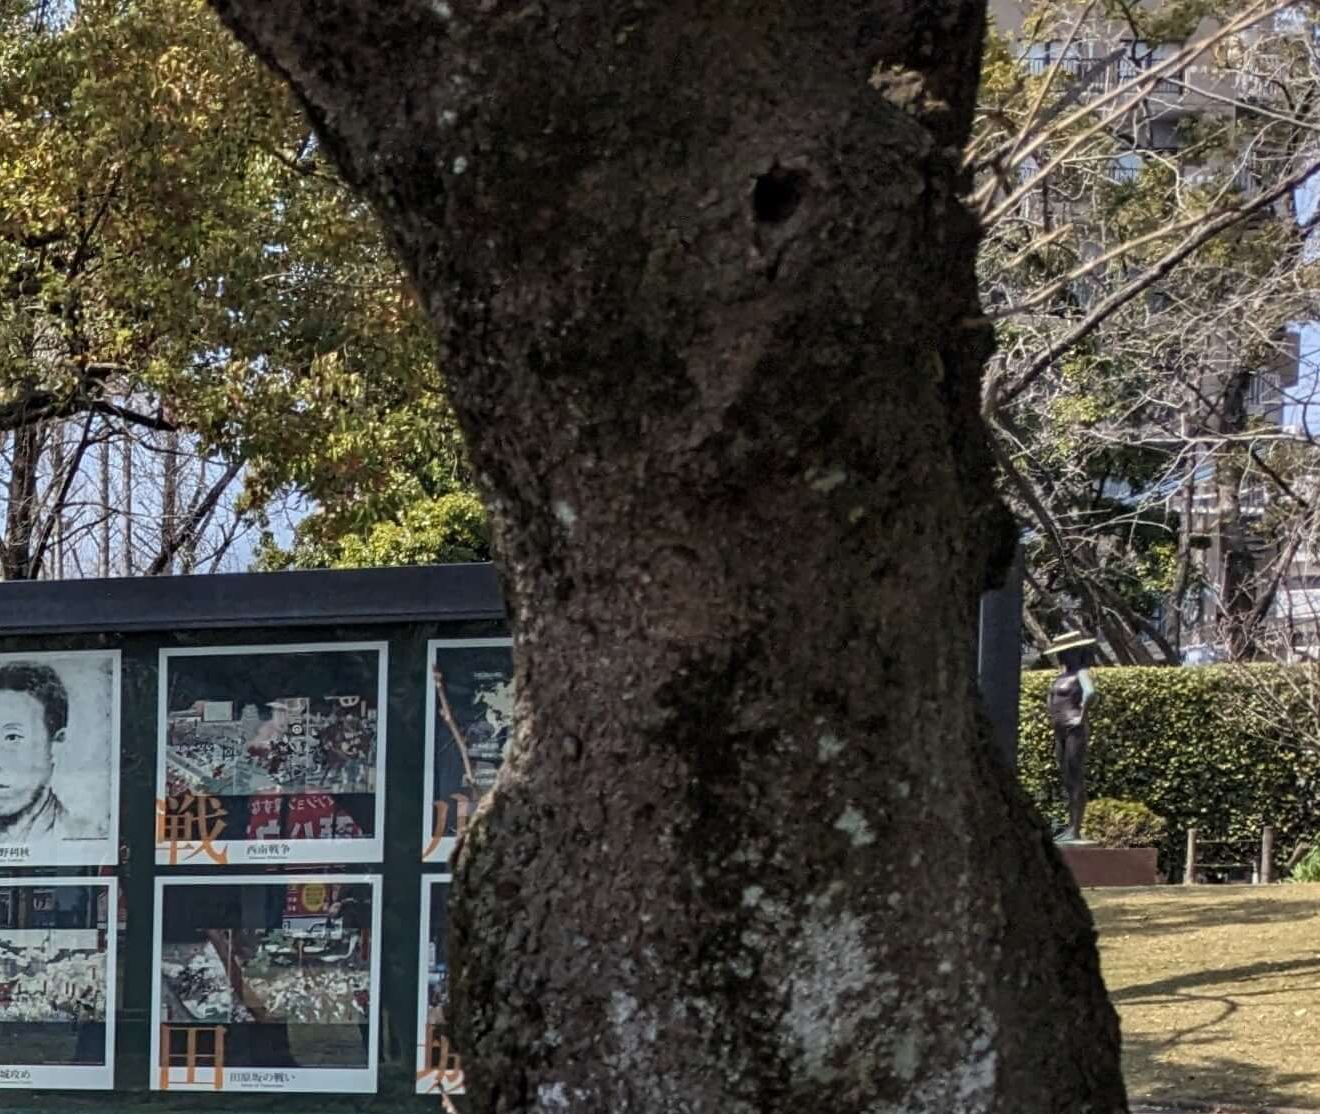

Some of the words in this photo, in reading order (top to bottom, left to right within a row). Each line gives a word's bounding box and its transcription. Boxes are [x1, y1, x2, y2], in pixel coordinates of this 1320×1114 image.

[157, 795, 228, 865] 戦
[246, 844, 291, 856] 西南戦争
[159, 1022, 228, 1090] 田
